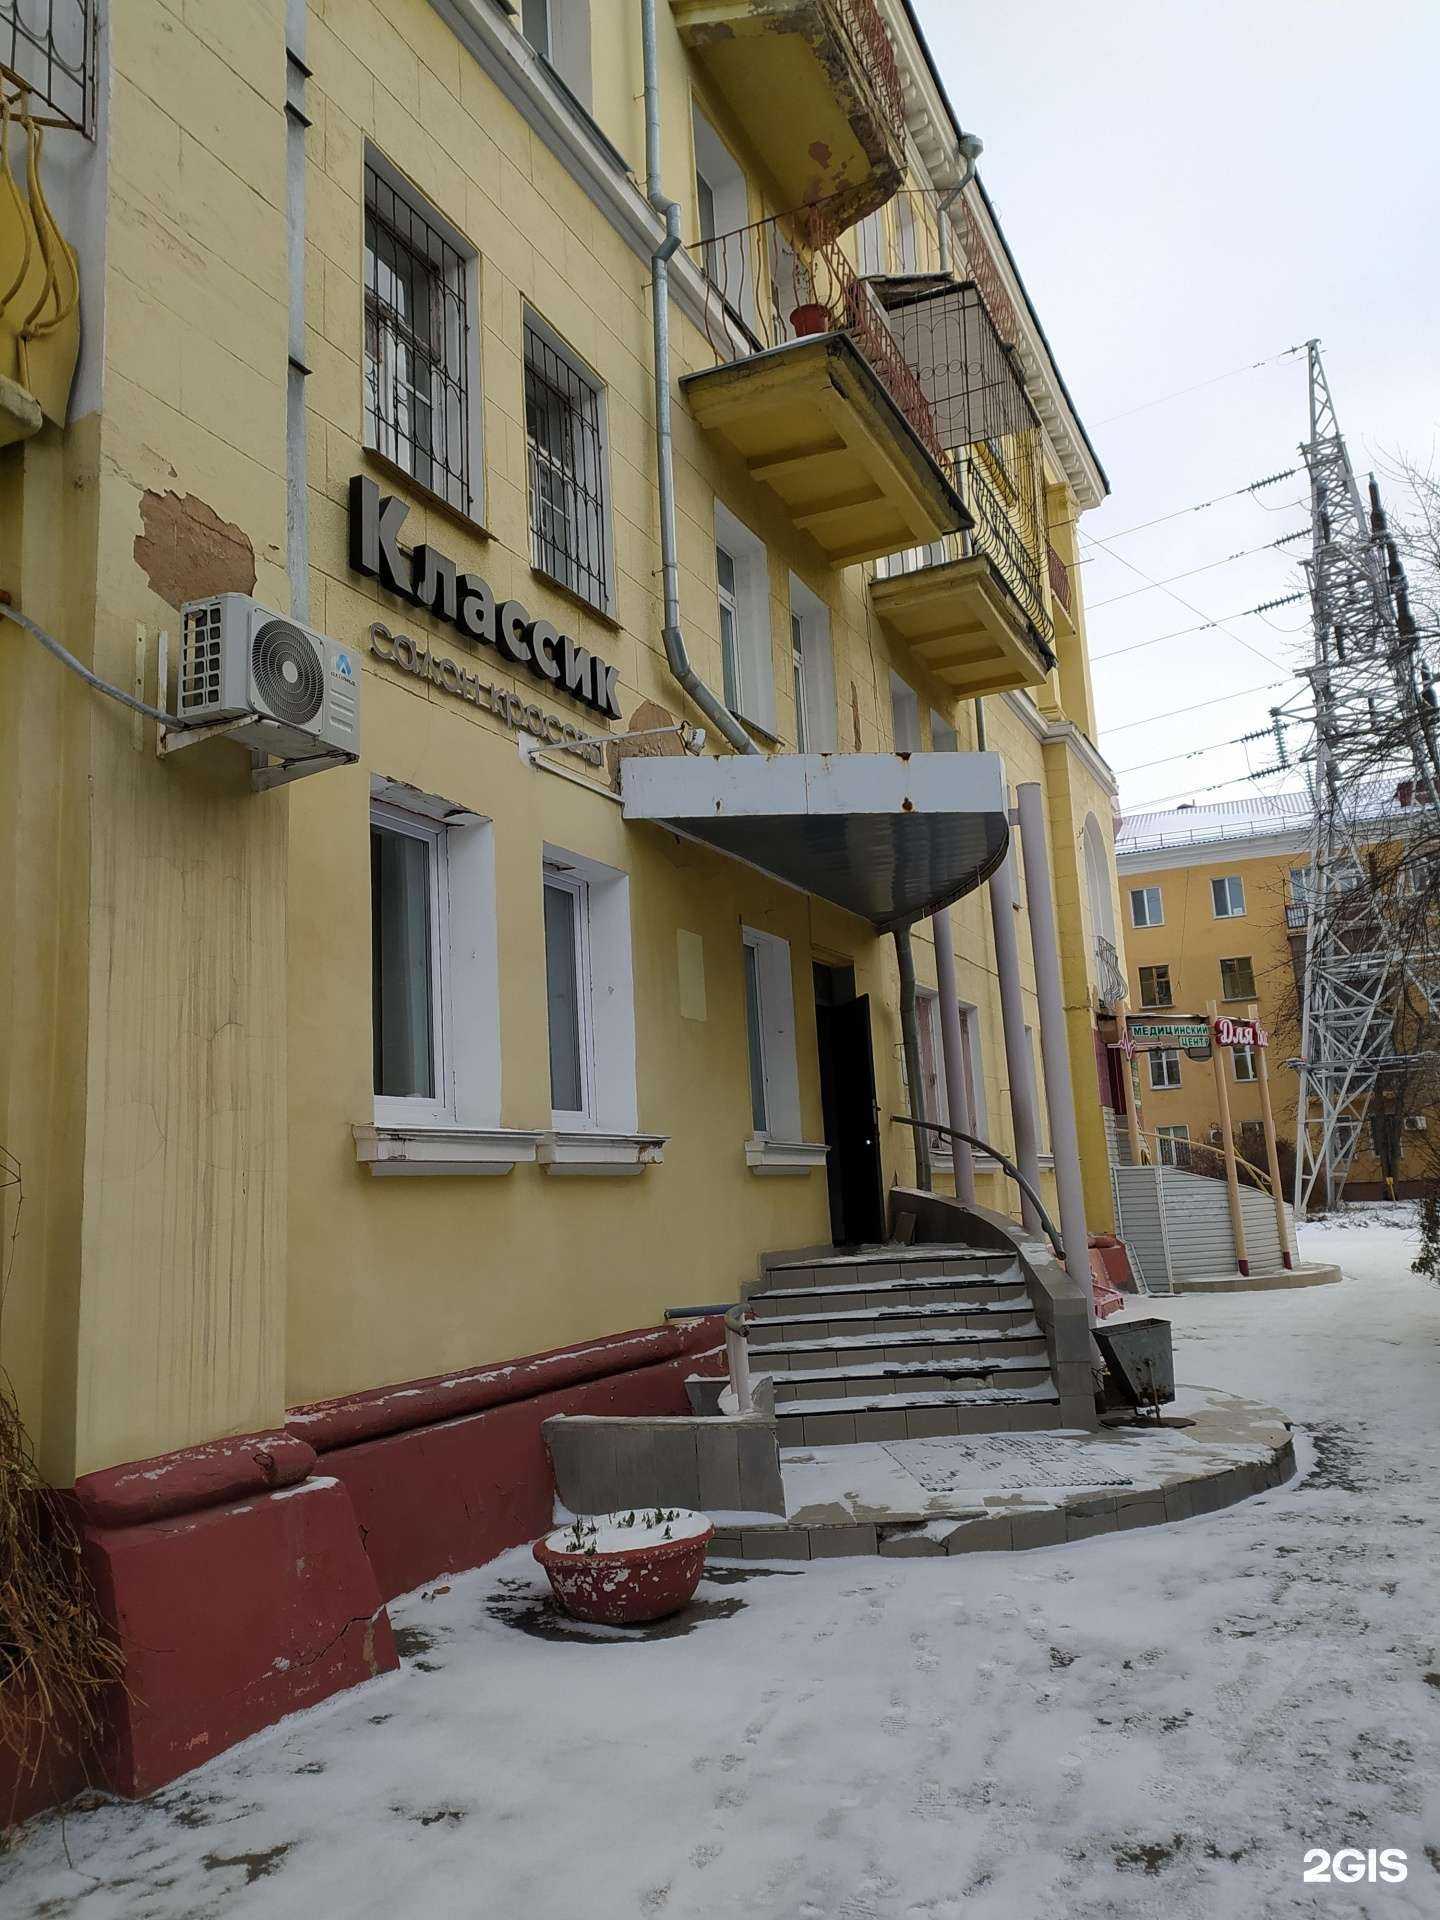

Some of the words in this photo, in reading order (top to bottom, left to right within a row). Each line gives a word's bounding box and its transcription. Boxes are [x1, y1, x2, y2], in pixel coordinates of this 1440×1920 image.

[350, 474, 622, 720] Классик
[1133, 1023, 1208, 1037] МЕДИЦИНСКИЙ
[1219, 1018, 1254, 1044] Для
[1181, 1037, 1209, 1047] ЦЕНТР
